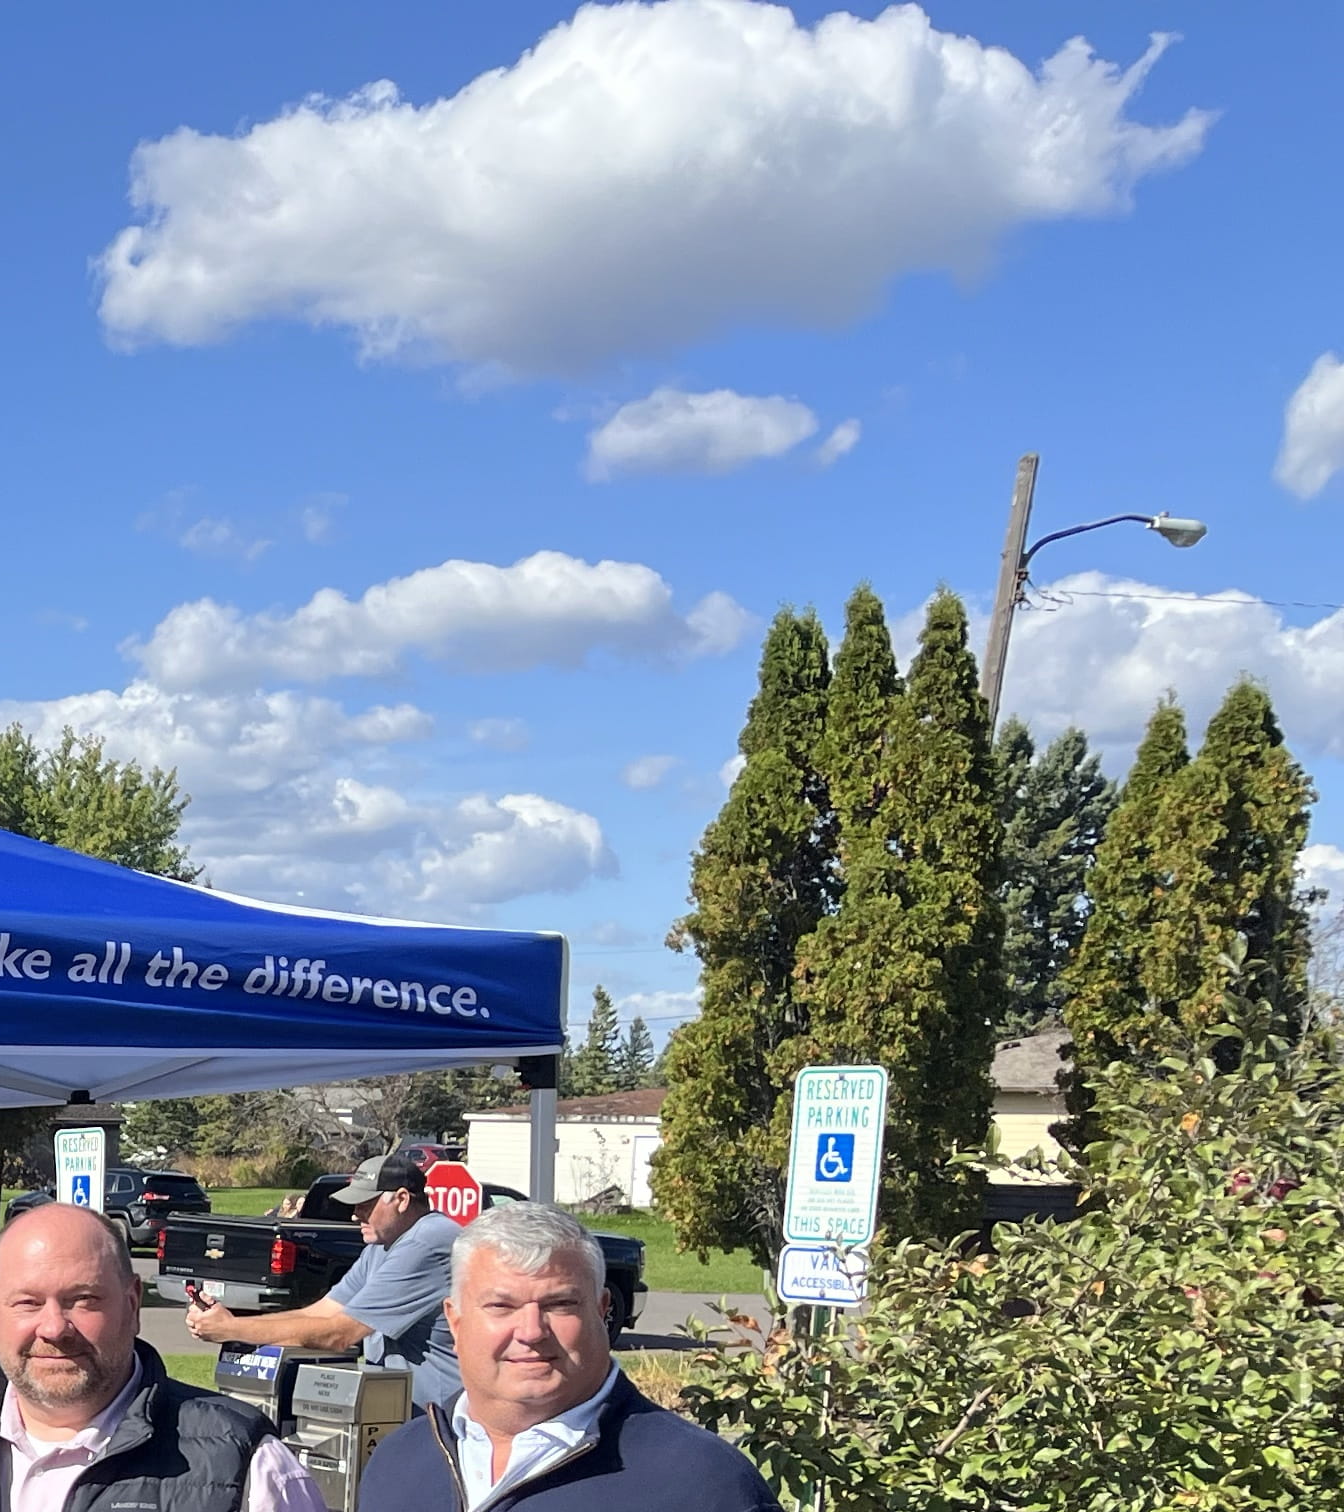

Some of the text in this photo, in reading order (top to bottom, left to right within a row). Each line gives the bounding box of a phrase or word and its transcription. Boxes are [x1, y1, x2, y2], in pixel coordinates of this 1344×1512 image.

[67, 941, 132, 985] all
[144, 946, 230, 991] the
[242, 955, 491, 1020] difference.
[806, 1078, 875, 1101] RESERVED
[807, 1106, 870, 1129] PARKING
[62, 1136, 99, 1153] RESERVED
[423, 1185, 477, 1217] STOP
[793, 1215, 865, 1235] THIS SPACE
[810, 1254, 841, 1273] VAN
